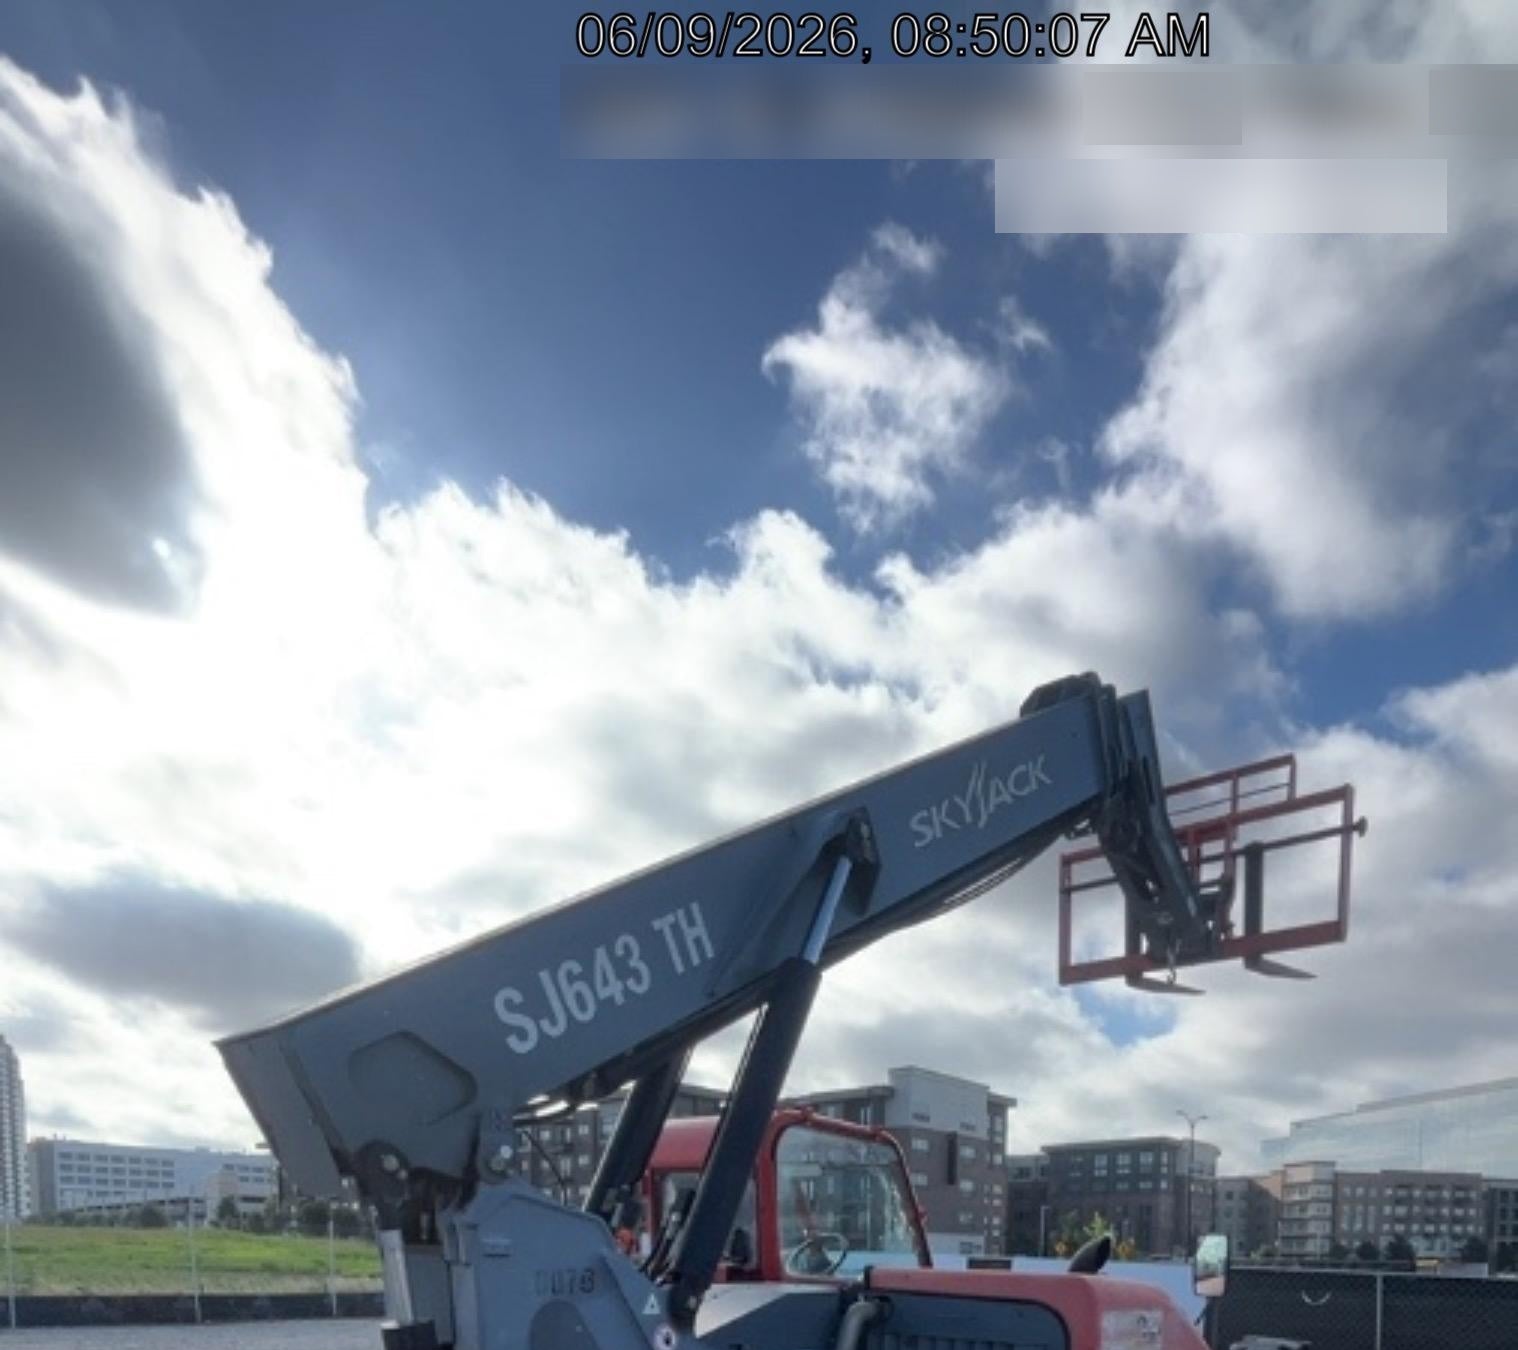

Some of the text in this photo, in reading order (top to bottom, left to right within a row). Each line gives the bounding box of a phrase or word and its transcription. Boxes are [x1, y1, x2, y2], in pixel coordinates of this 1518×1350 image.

[909, 753, 1053, 849] SKYJACK
[493, 901, 716, 1054] SJ643 TH
